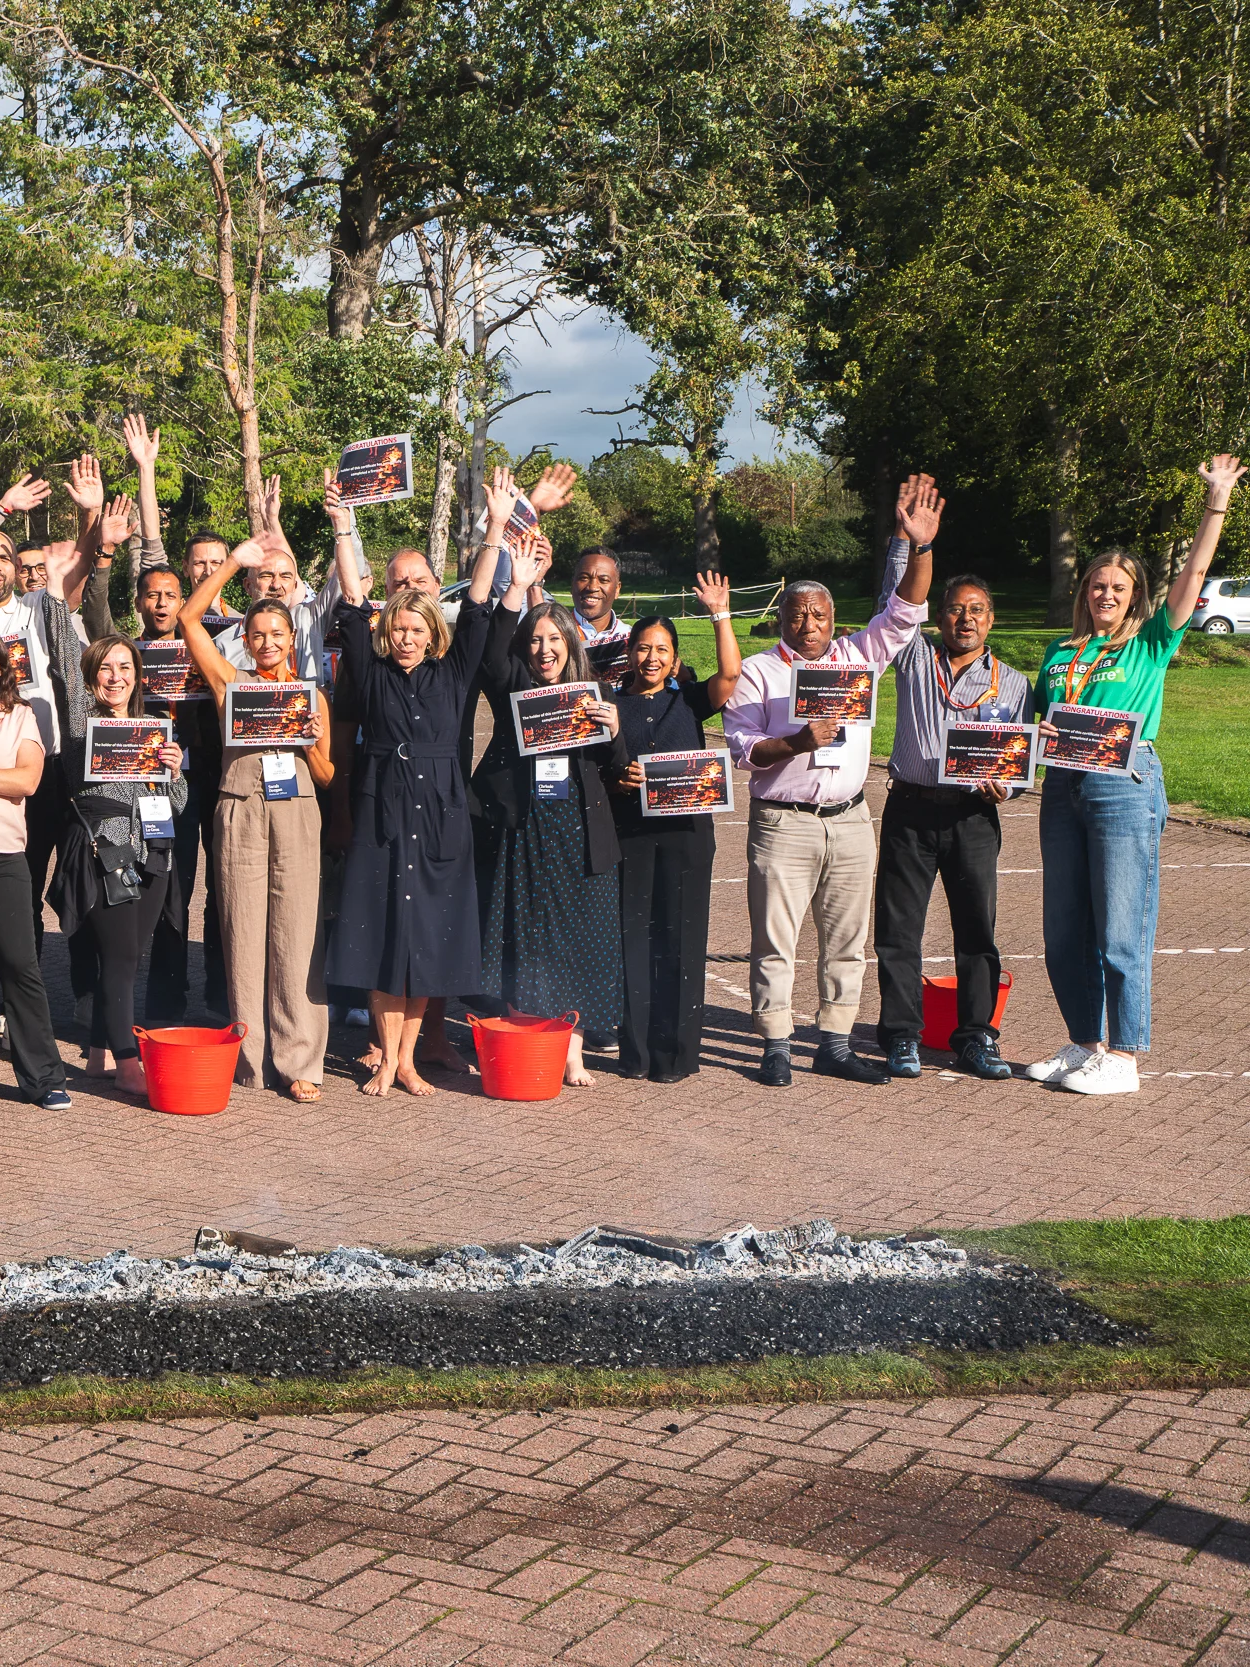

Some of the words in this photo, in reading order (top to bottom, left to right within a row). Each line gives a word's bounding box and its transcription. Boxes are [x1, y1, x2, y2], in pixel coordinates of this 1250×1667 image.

[523, 684, 587, 699] CONGRATULATIONS
[1061, 706, 1130, 720] CONGRATULATIONS
[955, 723, 1025, 732] CONGRATULATIONS
[651, 752, 717, 762] CONGRATULATIONS
